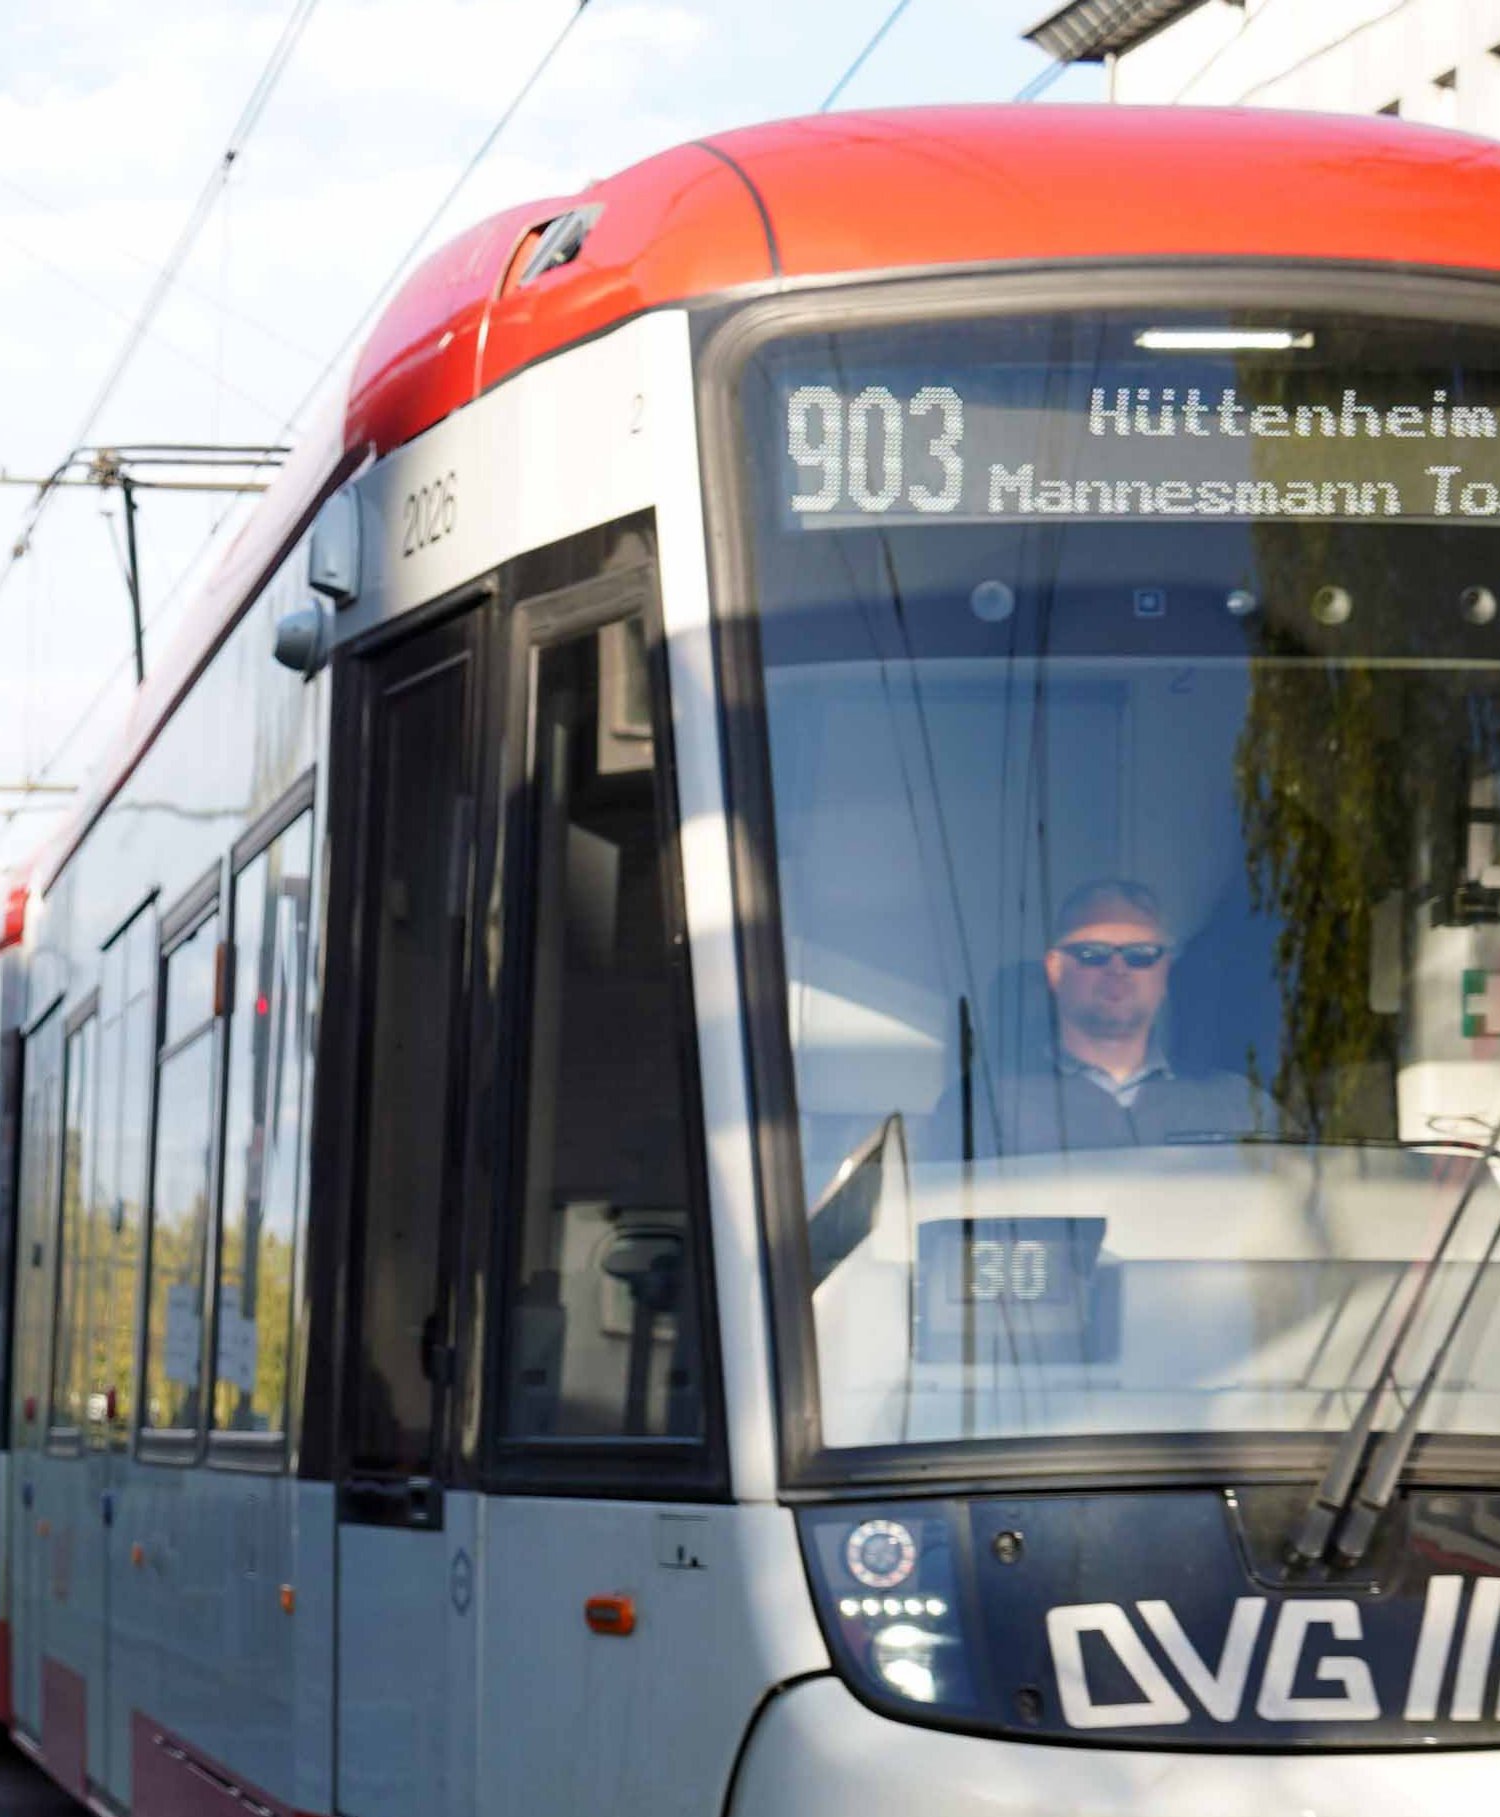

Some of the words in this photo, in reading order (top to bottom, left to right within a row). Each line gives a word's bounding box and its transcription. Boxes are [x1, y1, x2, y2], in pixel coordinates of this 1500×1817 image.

[1090, 387, 1498, 438] Hüttenheim
[788, 386, 964, 513] 903
[402, 471, 458, 560] 2026
[988, 463, 1400, 515] Mannesmann
[971, 1240, 1046, 1300] 30
